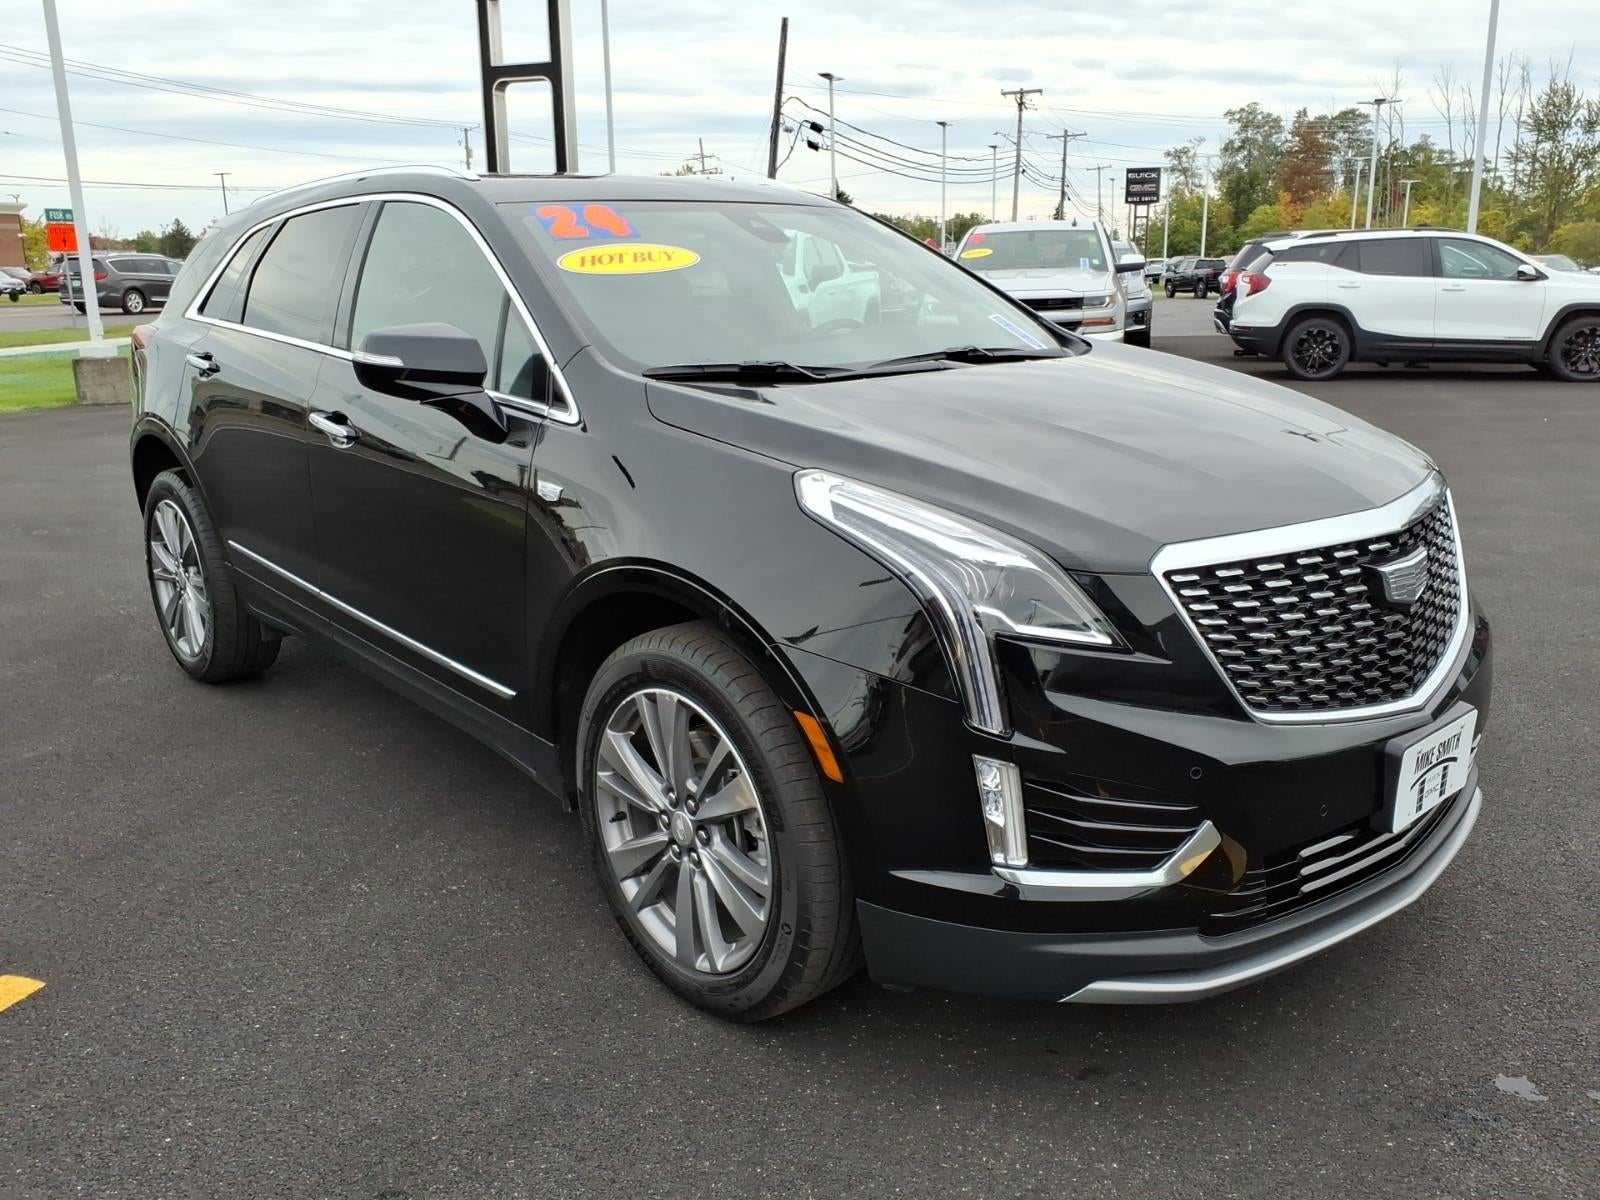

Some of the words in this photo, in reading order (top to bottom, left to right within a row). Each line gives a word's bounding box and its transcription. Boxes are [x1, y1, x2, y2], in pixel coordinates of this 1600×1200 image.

[49, 211, 64, 220] FISK
[536, 204, 632, 238] 24
[579, 252, 628, 267] HOT
[633, 251, 676, 263] BUY
[1414, 746, 1436, 775] MIKE
[1436, 731, 1461, 761] SMITH
